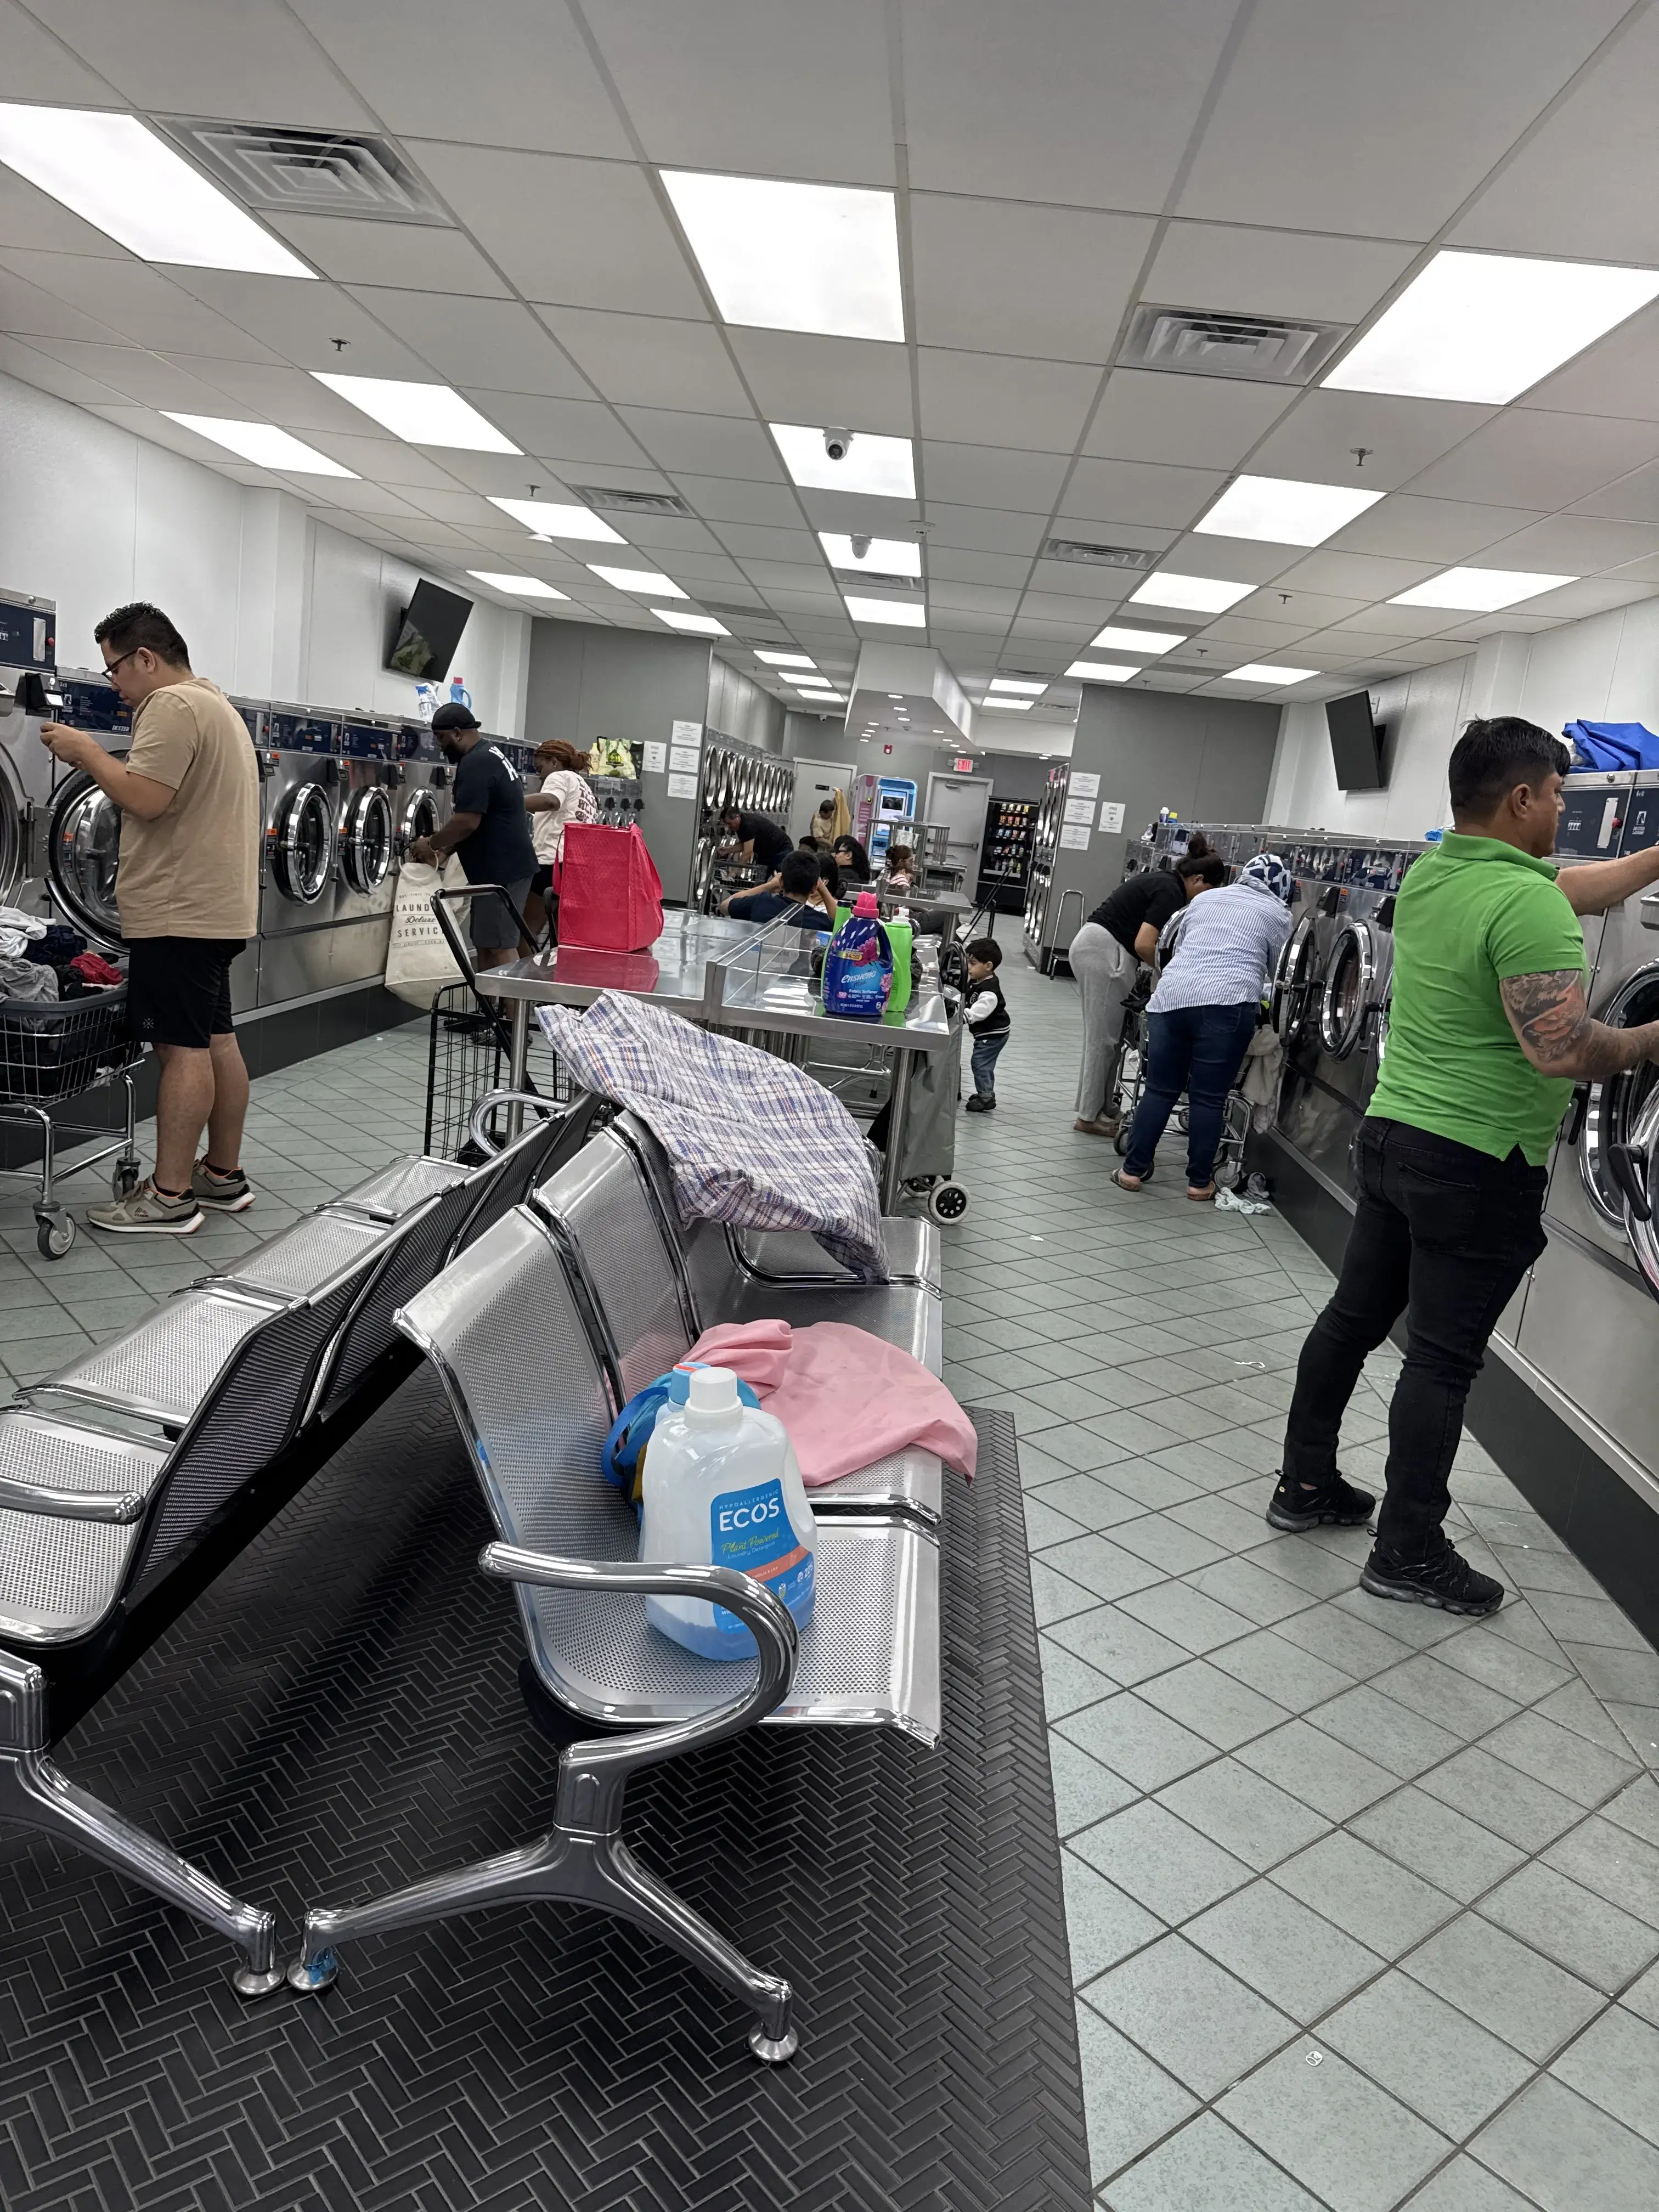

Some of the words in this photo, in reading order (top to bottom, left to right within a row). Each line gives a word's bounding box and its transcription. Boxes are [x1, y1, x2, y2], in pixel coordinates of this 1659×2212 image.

[957, 759, 971, 770] EXIT
[396, 904, 430, 912] LAUND
[719, 1489, 779, 1510] HYPOALLERGENIC
[719, 1497, 780, 1532] ECOS
[721, 1541, 747, 1554] Plant
[748, 1527, 780, 1547] Powered
[727, 1549, 751, 1560] Laundry
[752, 1541, 775, 1554] Detergent
